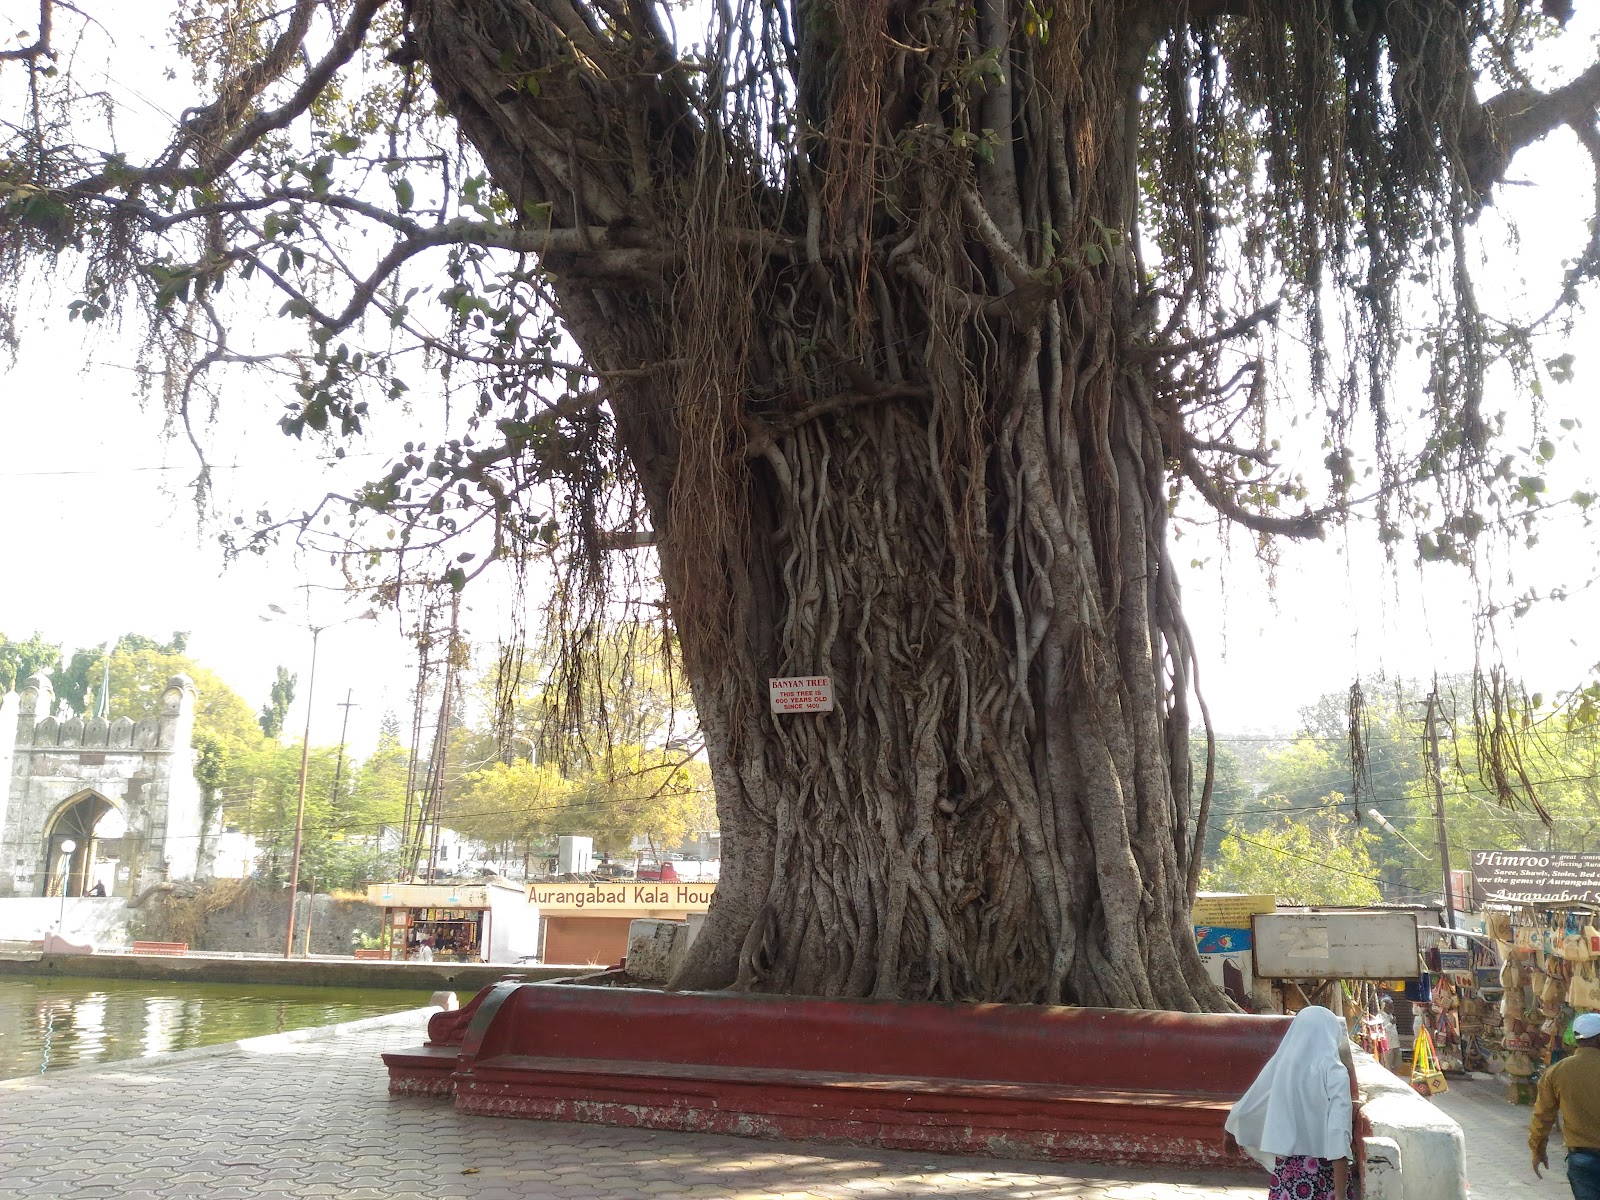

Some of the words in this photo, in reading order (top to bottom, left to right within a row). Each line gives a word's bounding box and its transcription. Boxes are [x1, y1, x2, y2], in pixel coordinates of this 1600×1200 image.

[772, 680, 804, 689] BANYAN
[806, 679, 828, 687] TREE
[1475, 851, 1550, 867] Himroo
[1551, 860, 1583, 869] reflecting
[1494, 868, 1518, 877] Saree,
[1520, 869, 1551, 878] Shawls,
[1552, 870, 1578, 878] Stoles,
[1535, 878, 1547, 886] of
[528, 886, 626, 908] Aurangabad
[634, 886, 669, 904] Kala
